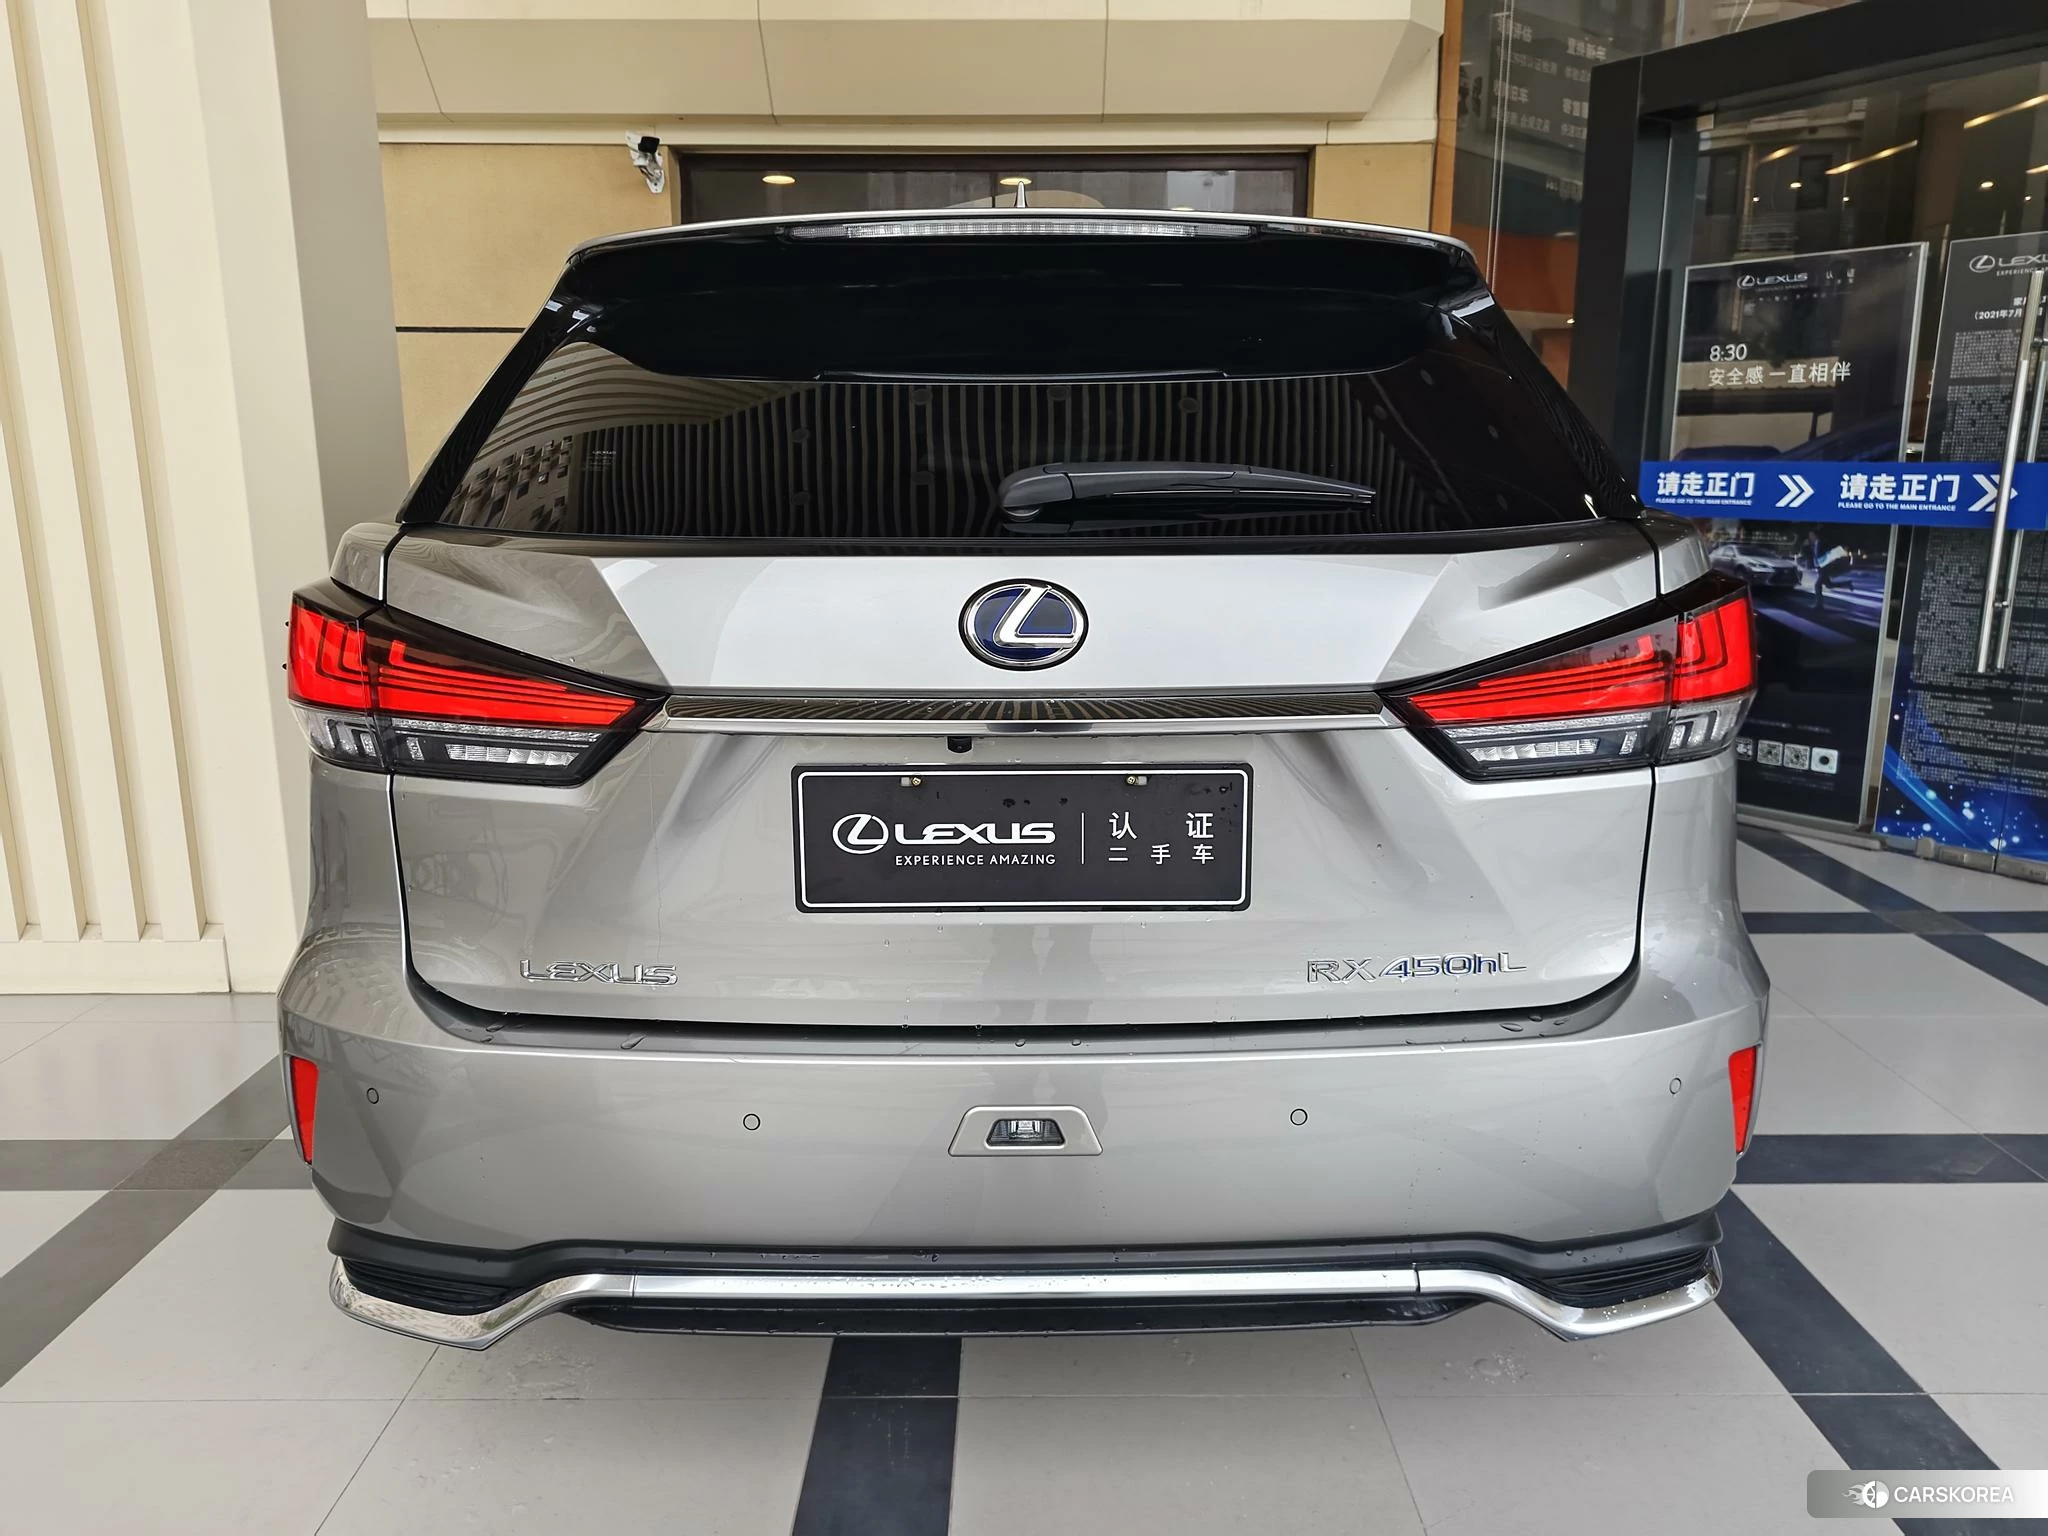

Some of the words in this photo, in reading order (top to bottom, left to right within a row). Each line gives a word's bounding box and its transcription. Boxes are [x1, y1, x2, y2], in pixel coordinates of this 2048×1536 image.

[1756, 272, 1808, 286] LEXUS
[1710, 343, 1748, 362] 8:30
[1708, 360, 1851, 387] 安全感一直相伴
[1657, 471, 1756, 498] 请走正门
[1840, 473, 1960, 503] 请走正门
[894, 822, 1056, 845] LEXUS
[895, 854, 984, 866] EXPERIENCE
[989, 853, 1056, 865] AMAZING
[519, 959, 678, 986] LEXUS
[1307, 958, 1376, 983] RX
[1378, 951, 1527, 978] 450hL
